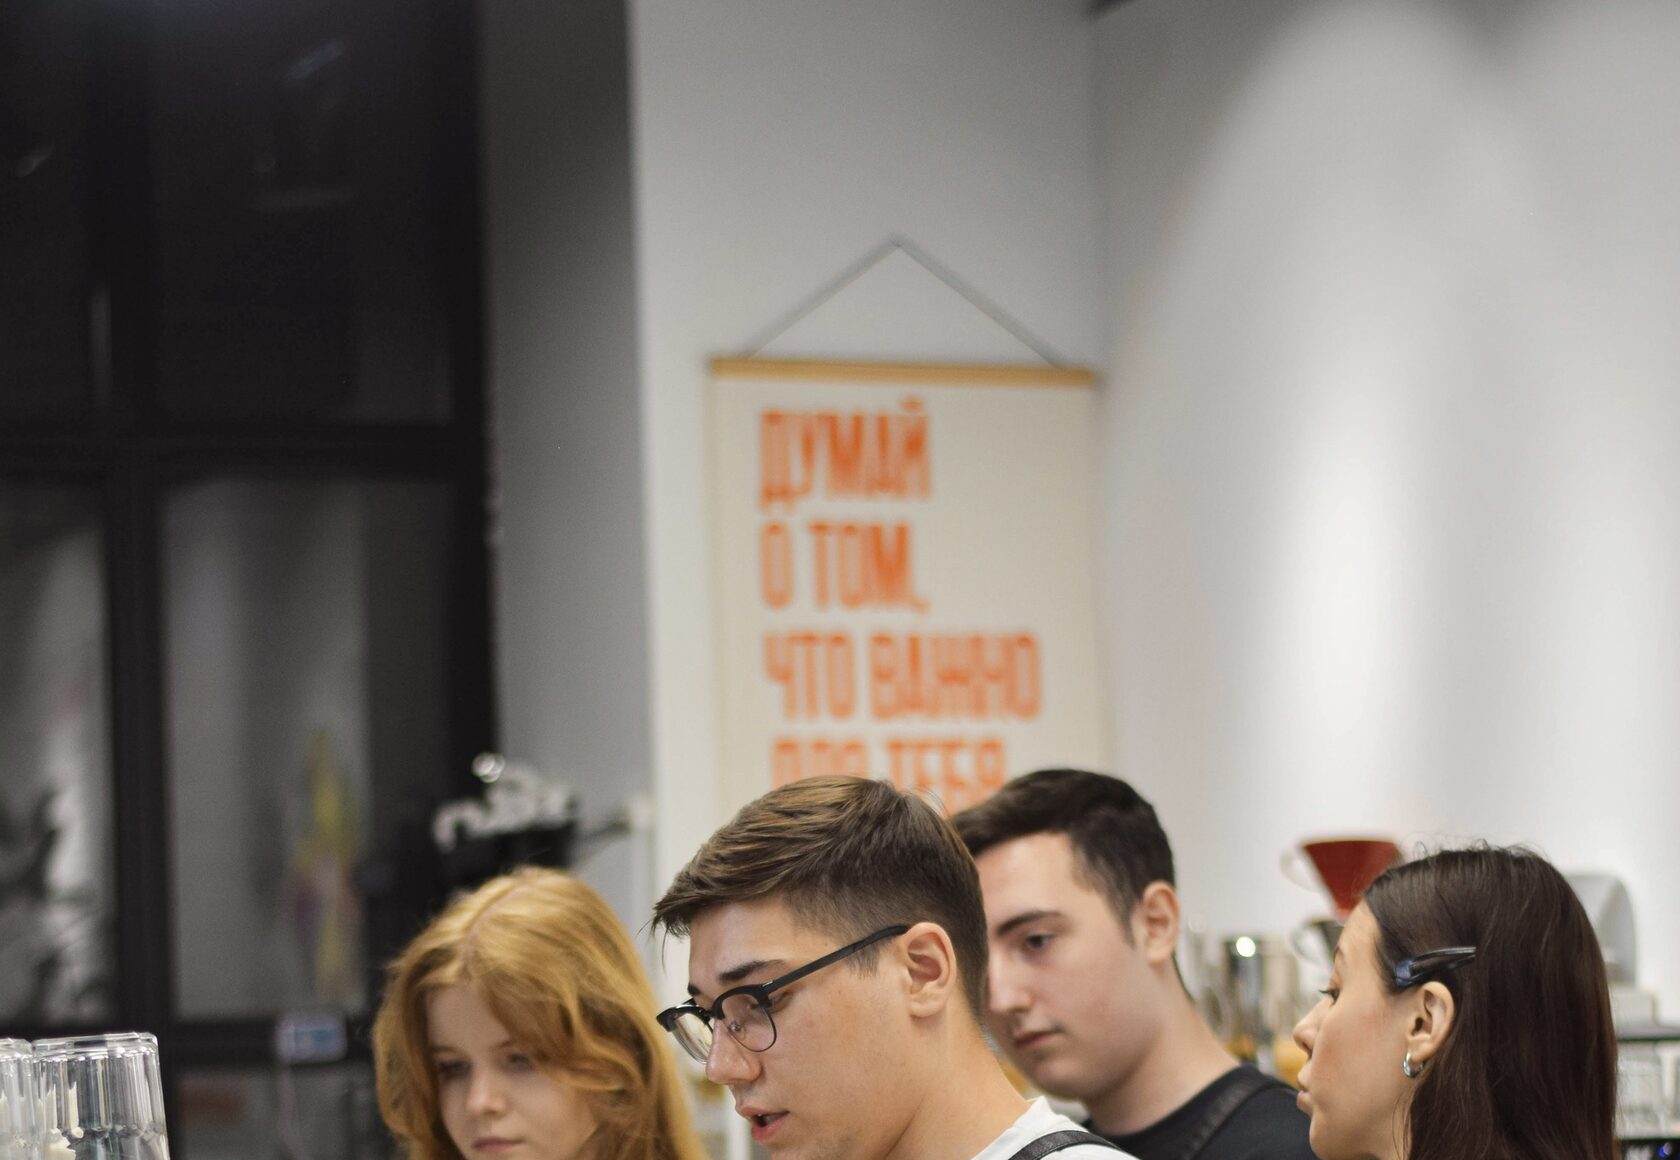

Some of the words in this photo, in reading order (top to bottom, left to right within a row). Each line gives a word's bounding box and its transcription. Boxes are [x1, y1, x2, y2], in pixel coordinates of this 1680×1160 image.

[760, 396, 929, 512] ДУМАЙ
[761, 521, 792, 608] О
[808, 521, 929, 613] ТОМ,
[763, 631, 855, 719] ЧТО
[870, 631, 1042, 719] ВАЖНО
